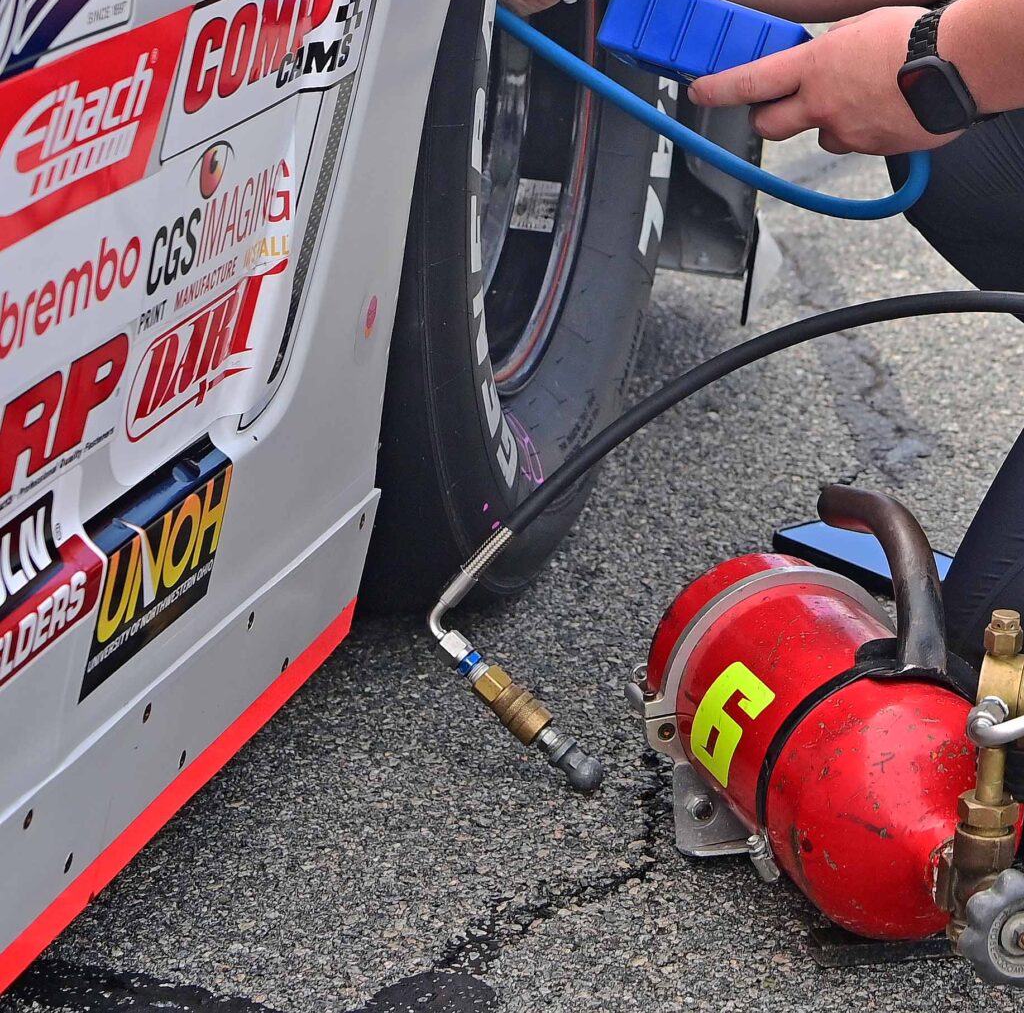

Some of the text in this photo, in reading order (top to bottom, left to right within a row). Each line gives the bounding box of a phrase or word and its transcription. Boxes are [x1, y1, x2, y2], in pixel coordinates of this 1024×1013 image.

[0, 51, 156, 183] Eibach
[275, 39, 351, 89] CAMS
[0, 235, 141, 360] brembo
[138, 299, 168, 335] PRINT
[174, 255, 239, 312] MANUFACTURE
[0, 332, 130, 500] RP
[0, 506, 53, 608] LN
[97, 463, 233, 643] UNOH
[0, 570, 87, 678] LDERS
[87, 625, 132, 674] UNIVERSITY
[139, 571, 199, 630] NORTHWESTERN
[196, 558, 215, 583] OHIO
[690, 660, 776, 788] 6
